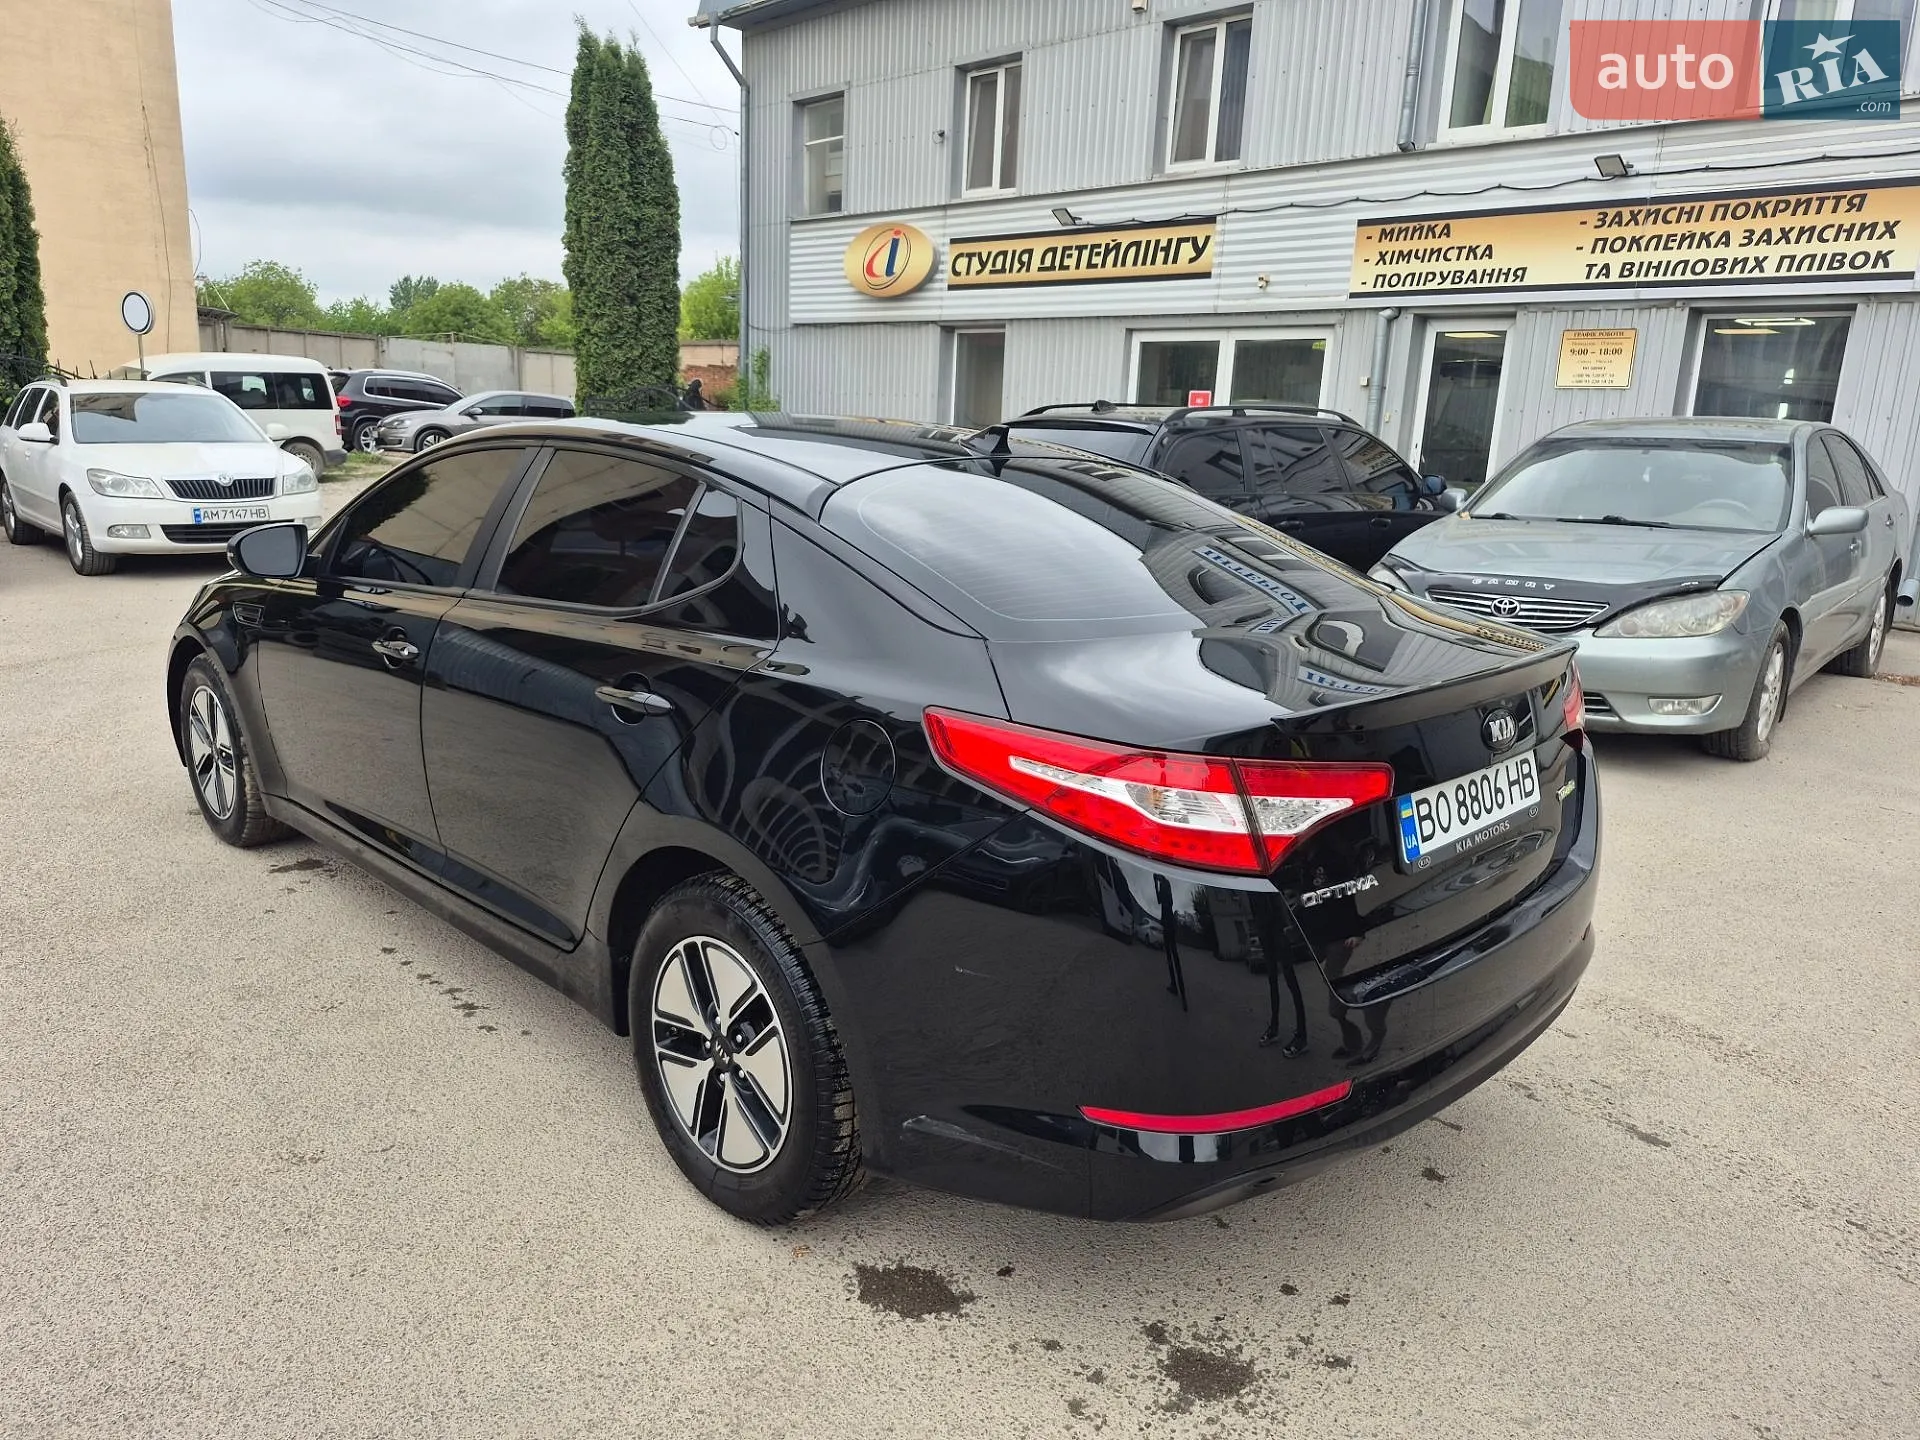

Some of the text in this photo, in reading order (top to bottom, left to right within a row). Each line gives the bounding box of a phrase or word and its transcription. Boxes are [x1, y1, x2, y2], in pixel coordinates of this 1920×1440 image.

[1593, 204, 1705, 229] ЗАХИСНІ
[1709, 193, 1868, 222] ПОКРИТТЯ
[1377, 222, 1451, 243] МИЙКА
[1590, 229, 1732, 255] ПОКЛЕЙКА
[1738, 219, 1902, 248] ЗАХИСНИХ
[951, 235, 1212, 278] СТУДІЯ ДЕТЕЙЛІНГУ
[1374, 244, 1494, 266] ХІМЧИСТКА
[1585, 249, 1895, 280] ТА ВІНІЛОВИХ ПЛІВОК
[1372, 266, 1528, 289] ПОЛІРУВАННЯ
[1570, 347, 1589, 356] 9:00
[1599, 347, 1623, 356] 18:00
[203, 509, 220, 520] AM
[222, 509, 248, 520] 7147
[250, 508, 267, 519] HB
[1489, 716, 1515, 742] KIA
[1415, 758, 1535, 843] BO 8806 HB
[1405, 834, 1418, 849] UA
[1455, 820, 1511, 854] KIA MOTORS
[1301, 873, 1380, 908] OPTIMA
